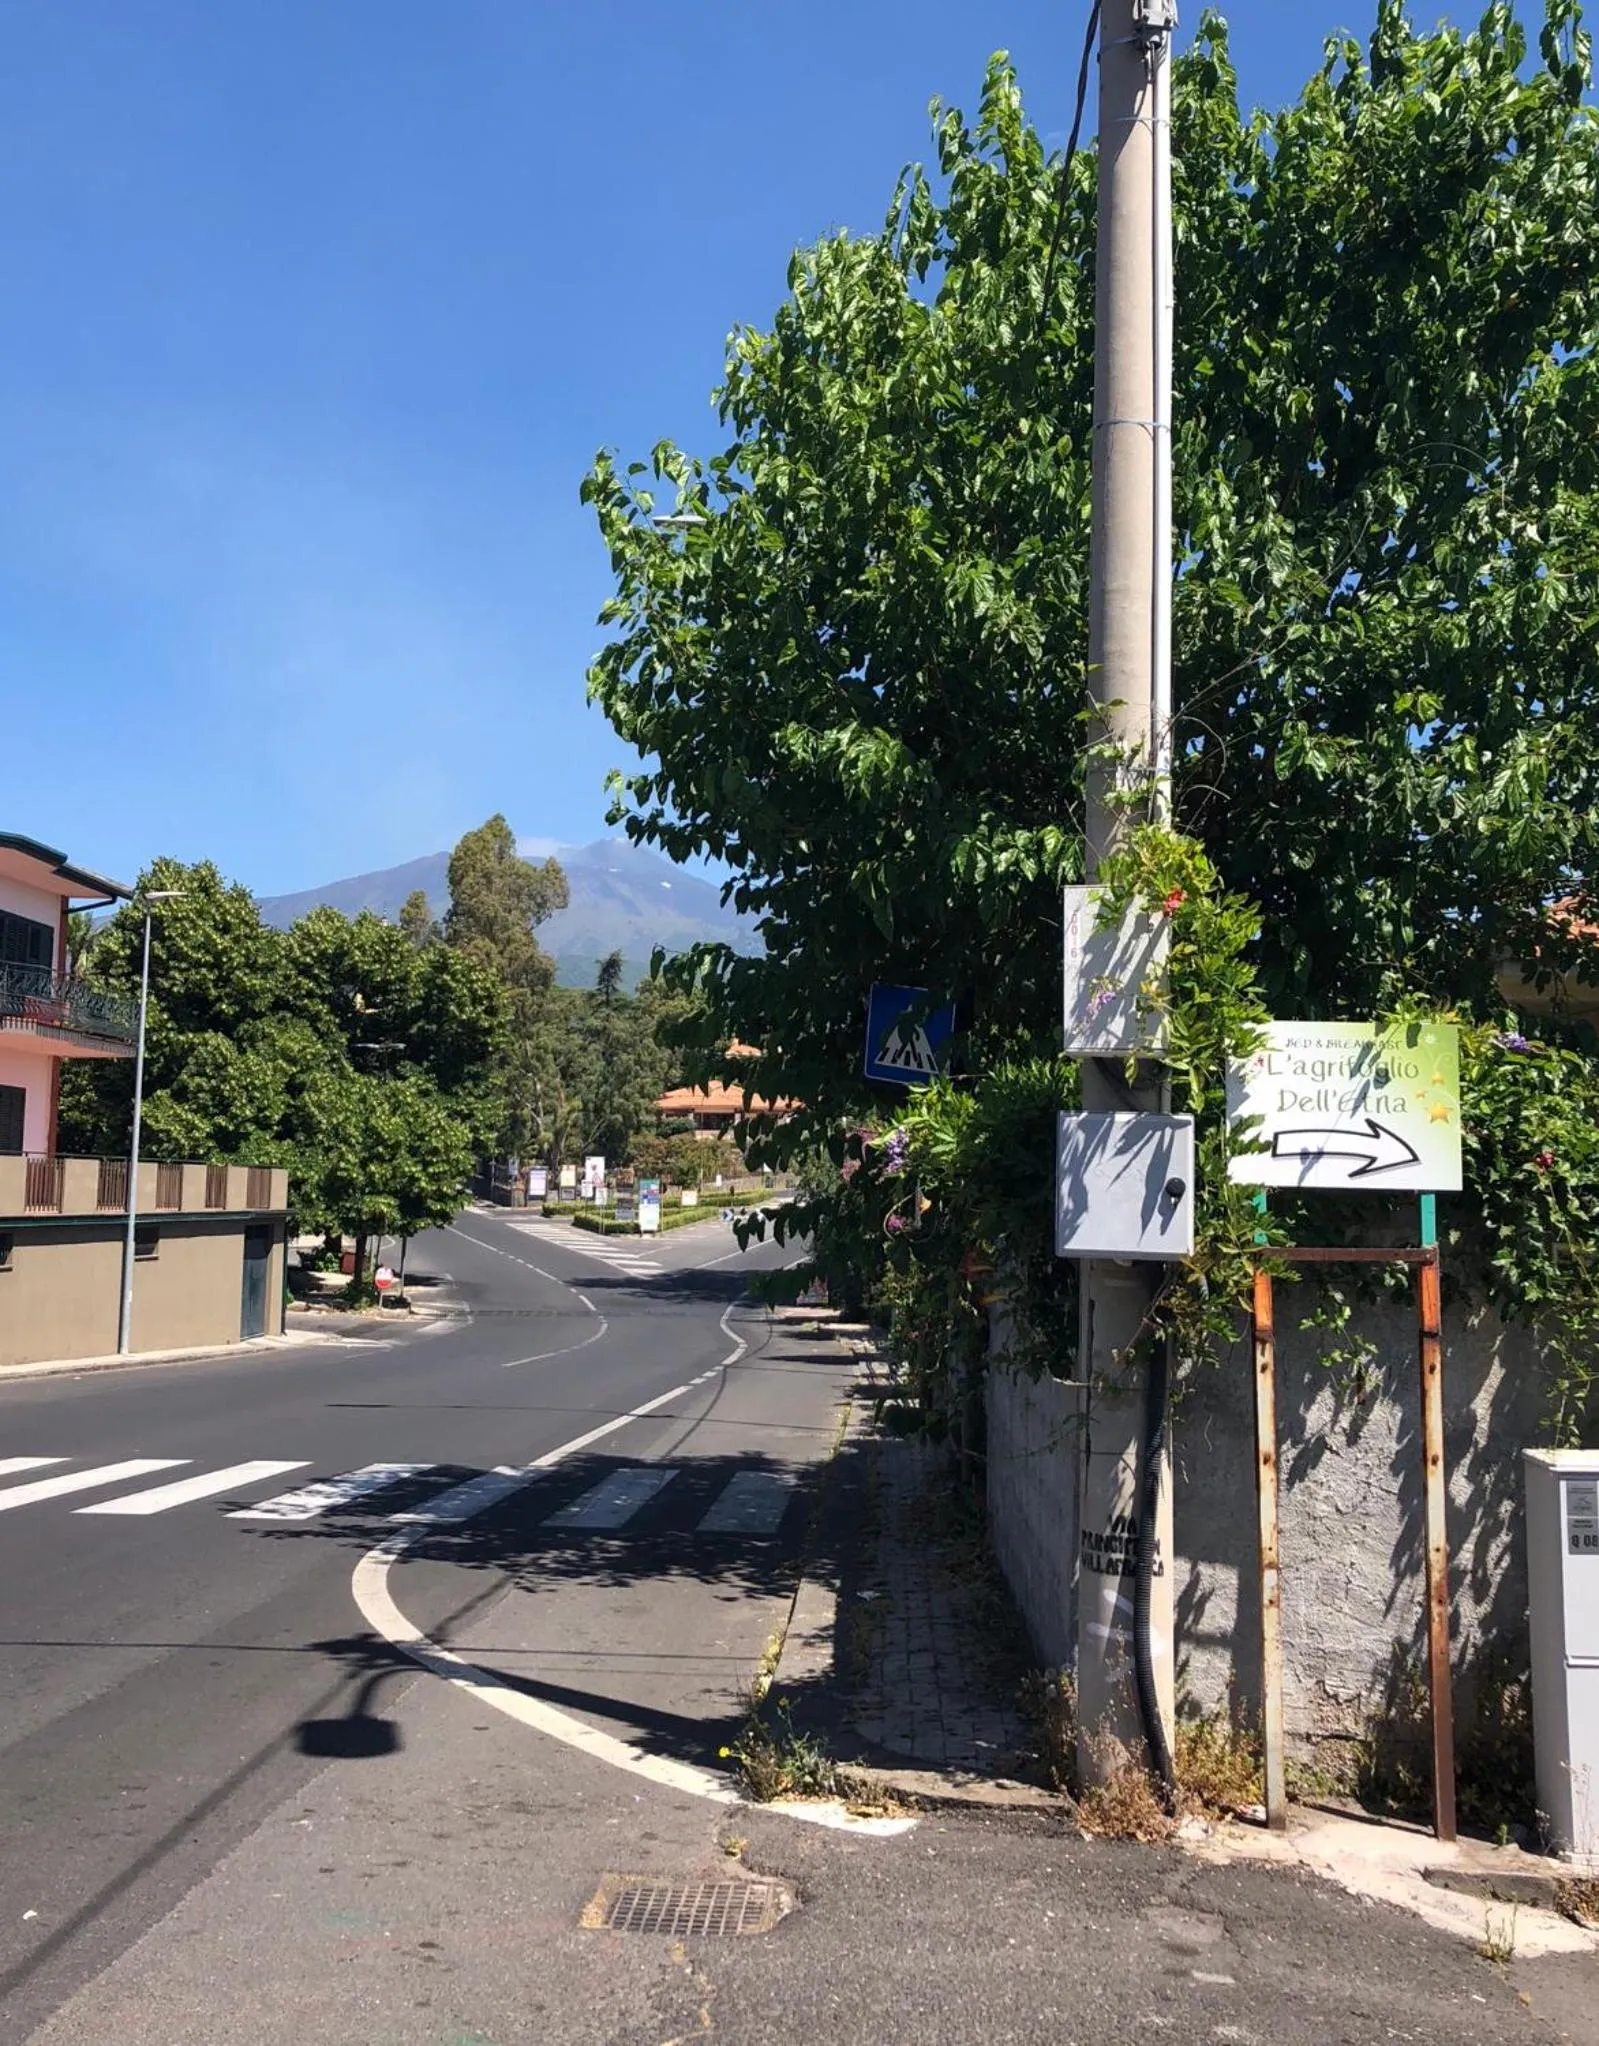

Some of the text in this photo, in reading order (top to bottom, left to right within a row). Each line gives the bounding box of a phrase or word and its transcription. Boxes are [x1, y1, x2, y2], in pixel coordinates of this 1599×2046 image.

[1286, 1037, 1312, 1049] BED
[1315, 1038, 1323, 1048] &
[1267, 1053, 1419, 1082] L'agrifoglio
[1276, 1088, 1409, 1114] Dell'Etna
